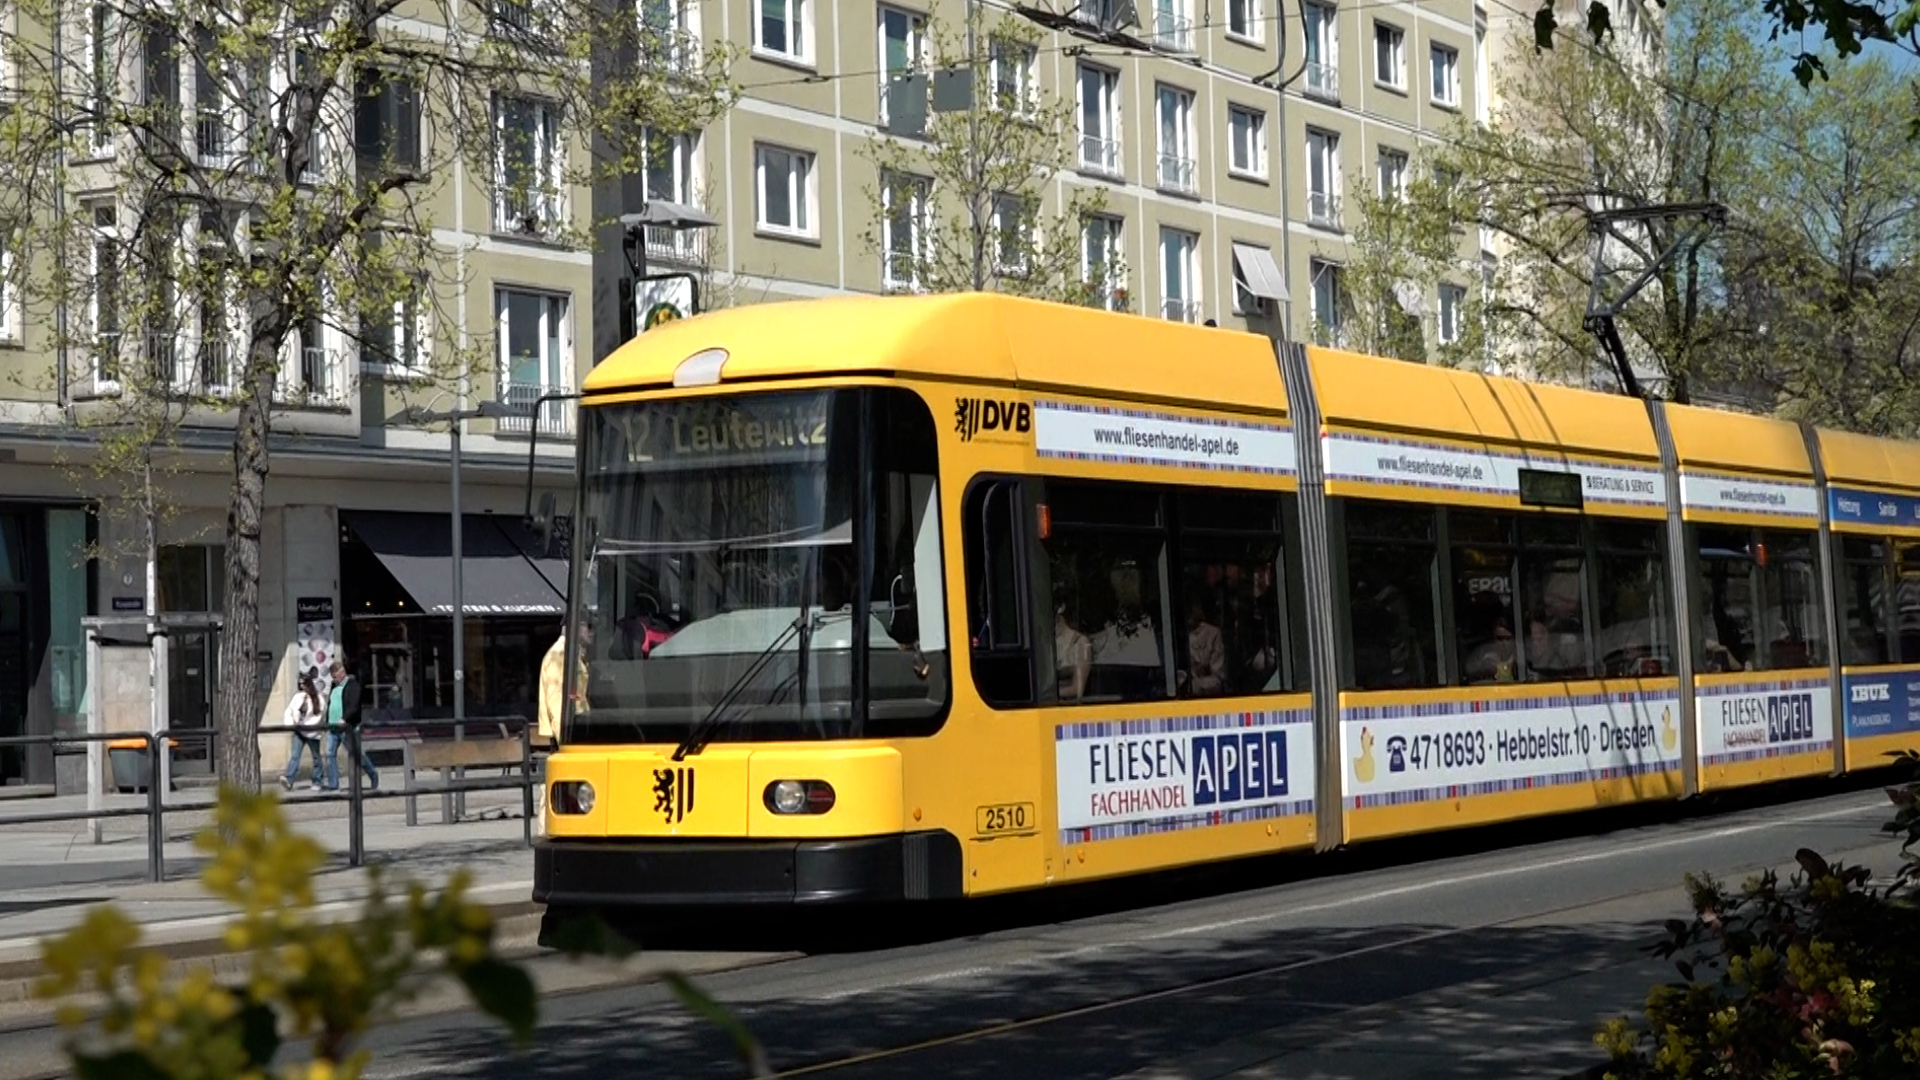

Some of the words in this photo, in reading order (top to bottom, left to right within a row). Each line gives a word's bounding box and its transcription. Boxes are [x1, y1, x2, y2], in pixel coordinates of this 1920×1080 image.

[622, 415, 653, 462] 12
[672, 404, 827, 454] Leutewitz
[982, 399, 1031, 433] DVB
[1094, 427, 1240, 456] www.fliesenhandel-apel.de
[435, 605, 490, 613] TOTEN
[1722, 696, 1766, 727] FLIESEN
[1768, 697, 1812, 737] APEL
[1089, 738, 1187, 784] FLIESEN
[1410, 729, 1486, 770] 4718693
[1599, 720, 1655, 752] Dresden
[1194, 742, 1285, 794] APEL
[986, 806, 1025, 829] 2510
[1091, 785, 1187, 816] FACHHANDEL
